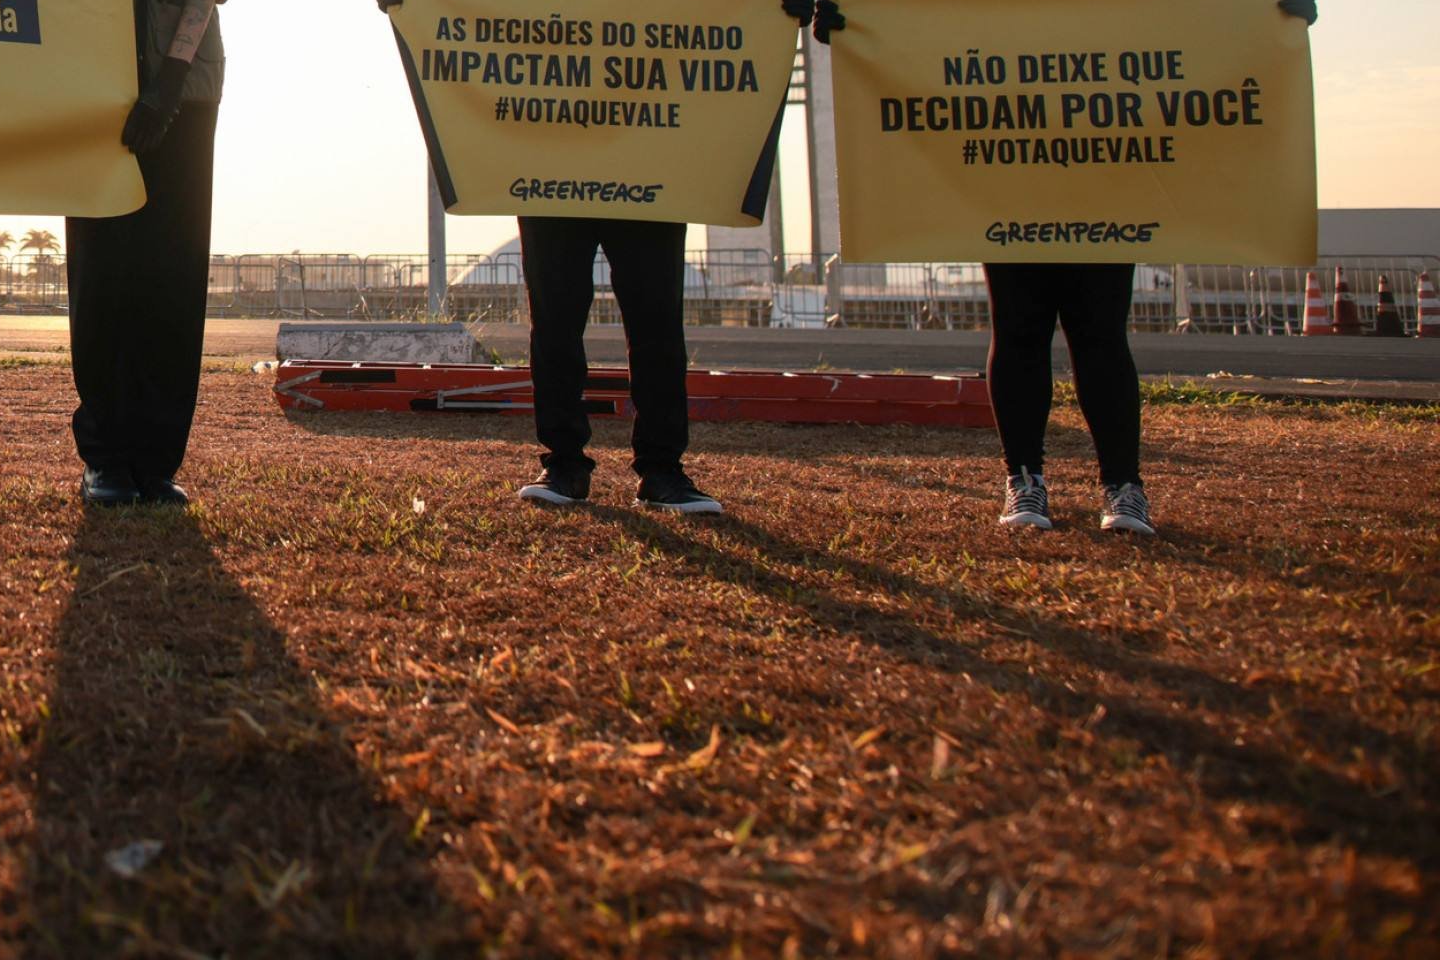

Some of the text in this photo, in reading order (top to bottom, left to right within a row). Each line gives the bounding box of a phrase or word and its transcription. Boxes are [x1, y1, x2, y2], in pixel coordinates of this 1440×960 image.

[436, 13, 743, 51] AS DECISÕES DO SENADO
[421, 49, 760, 93] IMPACTAM SUA VIDA
[943, 48, 1185, 86] NÃO DEIXE QUE
[494, 96, 681, 129] #VOTAQUEVALE
[879, 77, 1264, 132] DECIDAM POR VOCÊ
[962, 136, 1176, 168] #VOTAQUEVALE
[509, 177, 664, 204] GREENPEACE
[985, 221, 1161, 247] GREENPEACE
